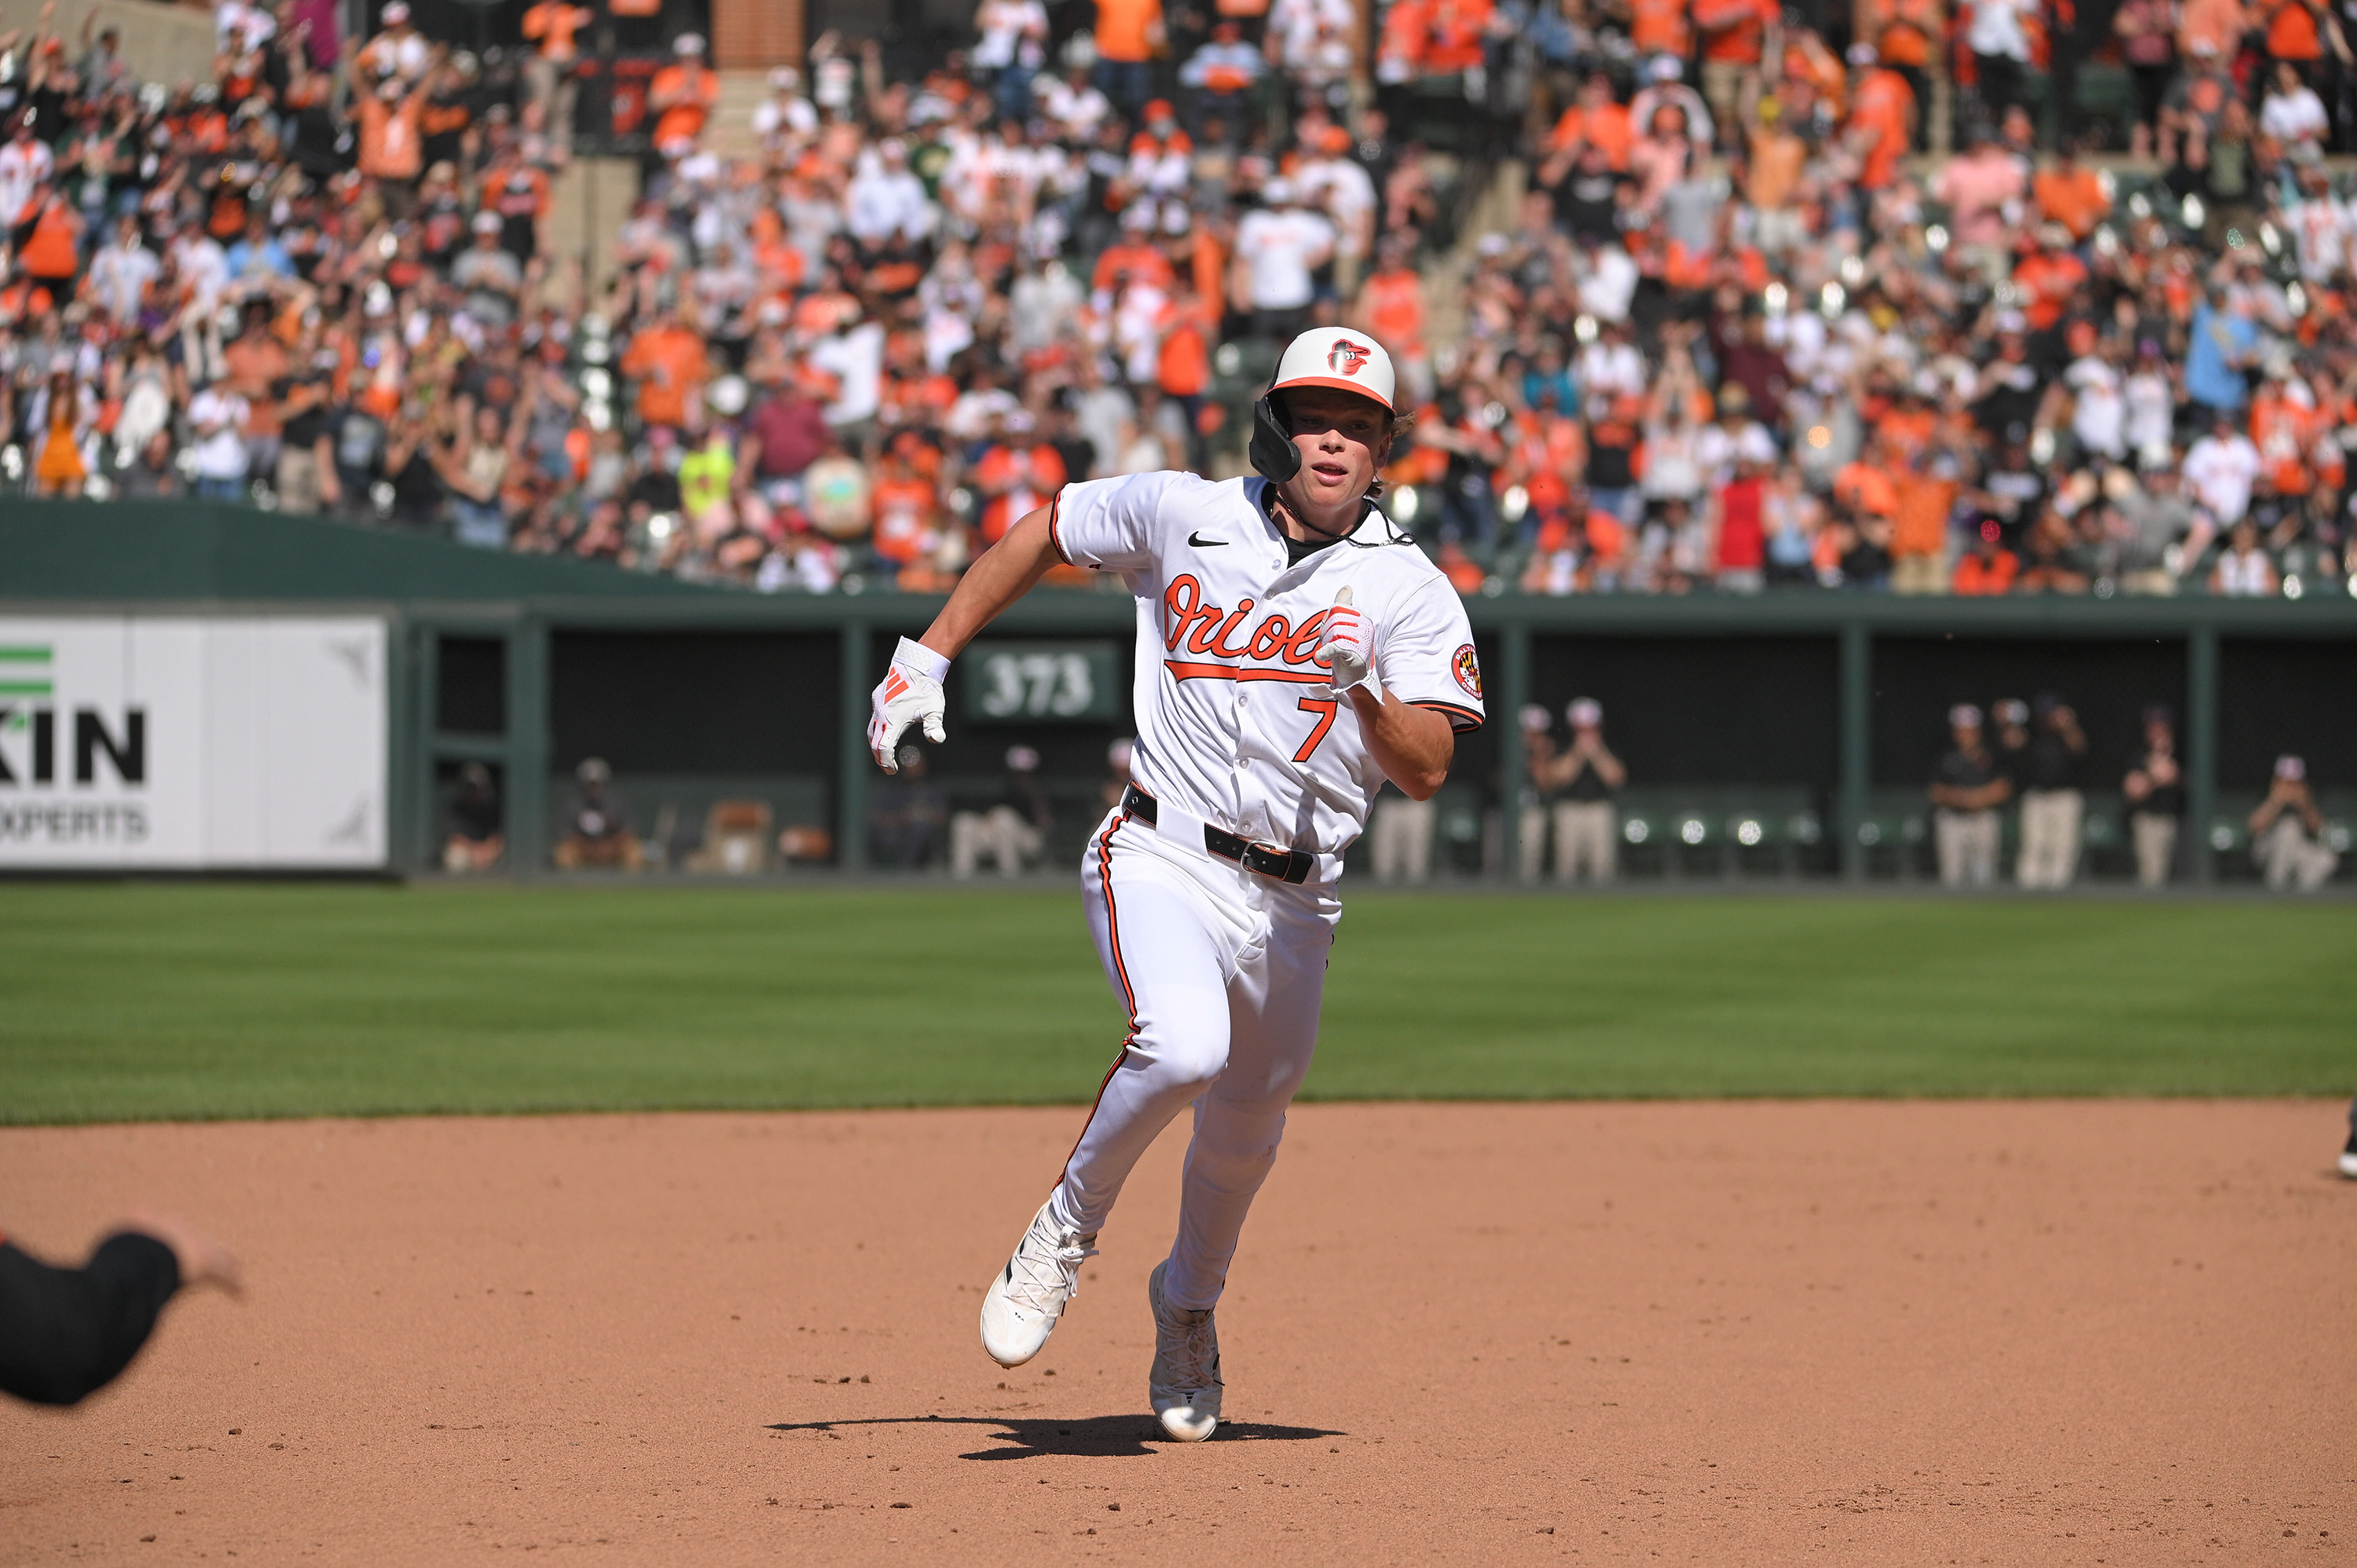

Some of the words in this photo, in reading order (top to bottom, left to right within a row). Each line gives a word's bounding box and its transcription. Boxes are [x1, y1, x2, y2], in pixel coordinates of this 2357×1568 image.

[1164, 573, 1333, 669] Oriol
[982, 653, 1094, 717] 373
[1292, 697, 1338, 764] 7
